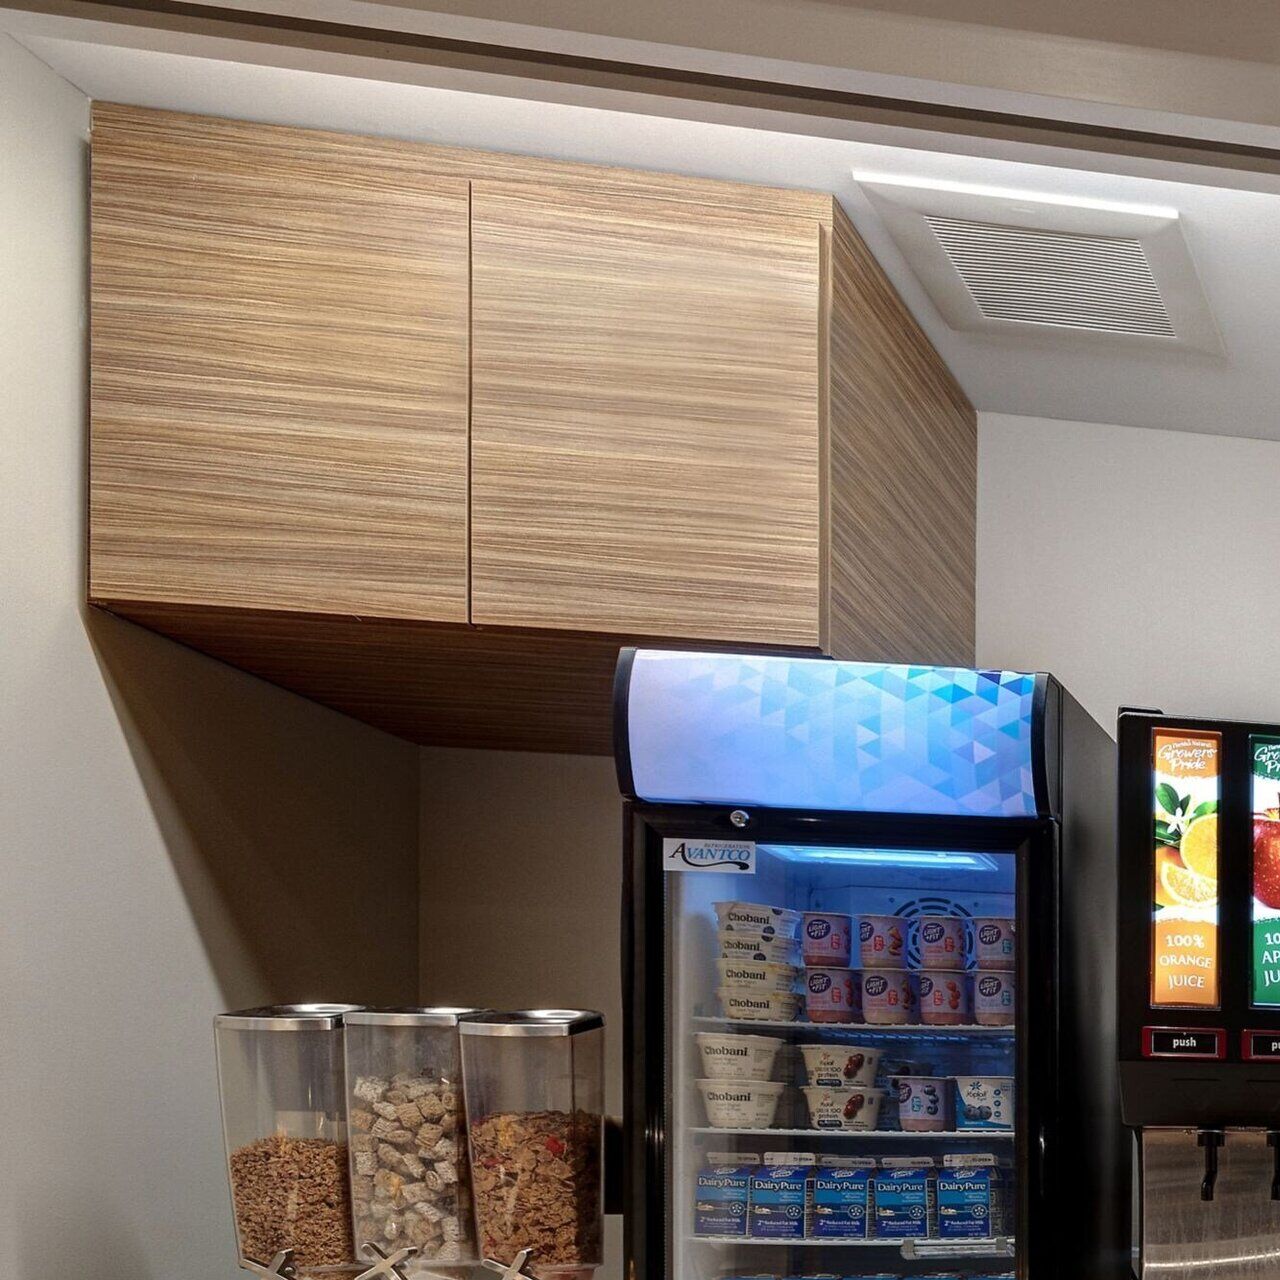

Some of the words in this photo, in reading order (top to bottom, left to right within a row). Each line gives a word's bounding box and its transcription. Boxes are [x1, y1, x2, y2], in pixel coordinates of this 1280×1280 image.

[669, 842, 751, 861] AVANTCO
[728, 912, 770, 924] Chobani
[1166, 934, 1205, 948] 100%
[1159, 954, 1213, 968] ORANGE
[726, 969, 766, 980] Chobani
[1168, 974, 1205, 989] JUICE
[729, 999, 770, 1009] Chobani
[1172, 1036, 1197, 1048] push
[704, 1046, 748, 1056] Chobani
[707, 1092, 751, 1102] Chobani
